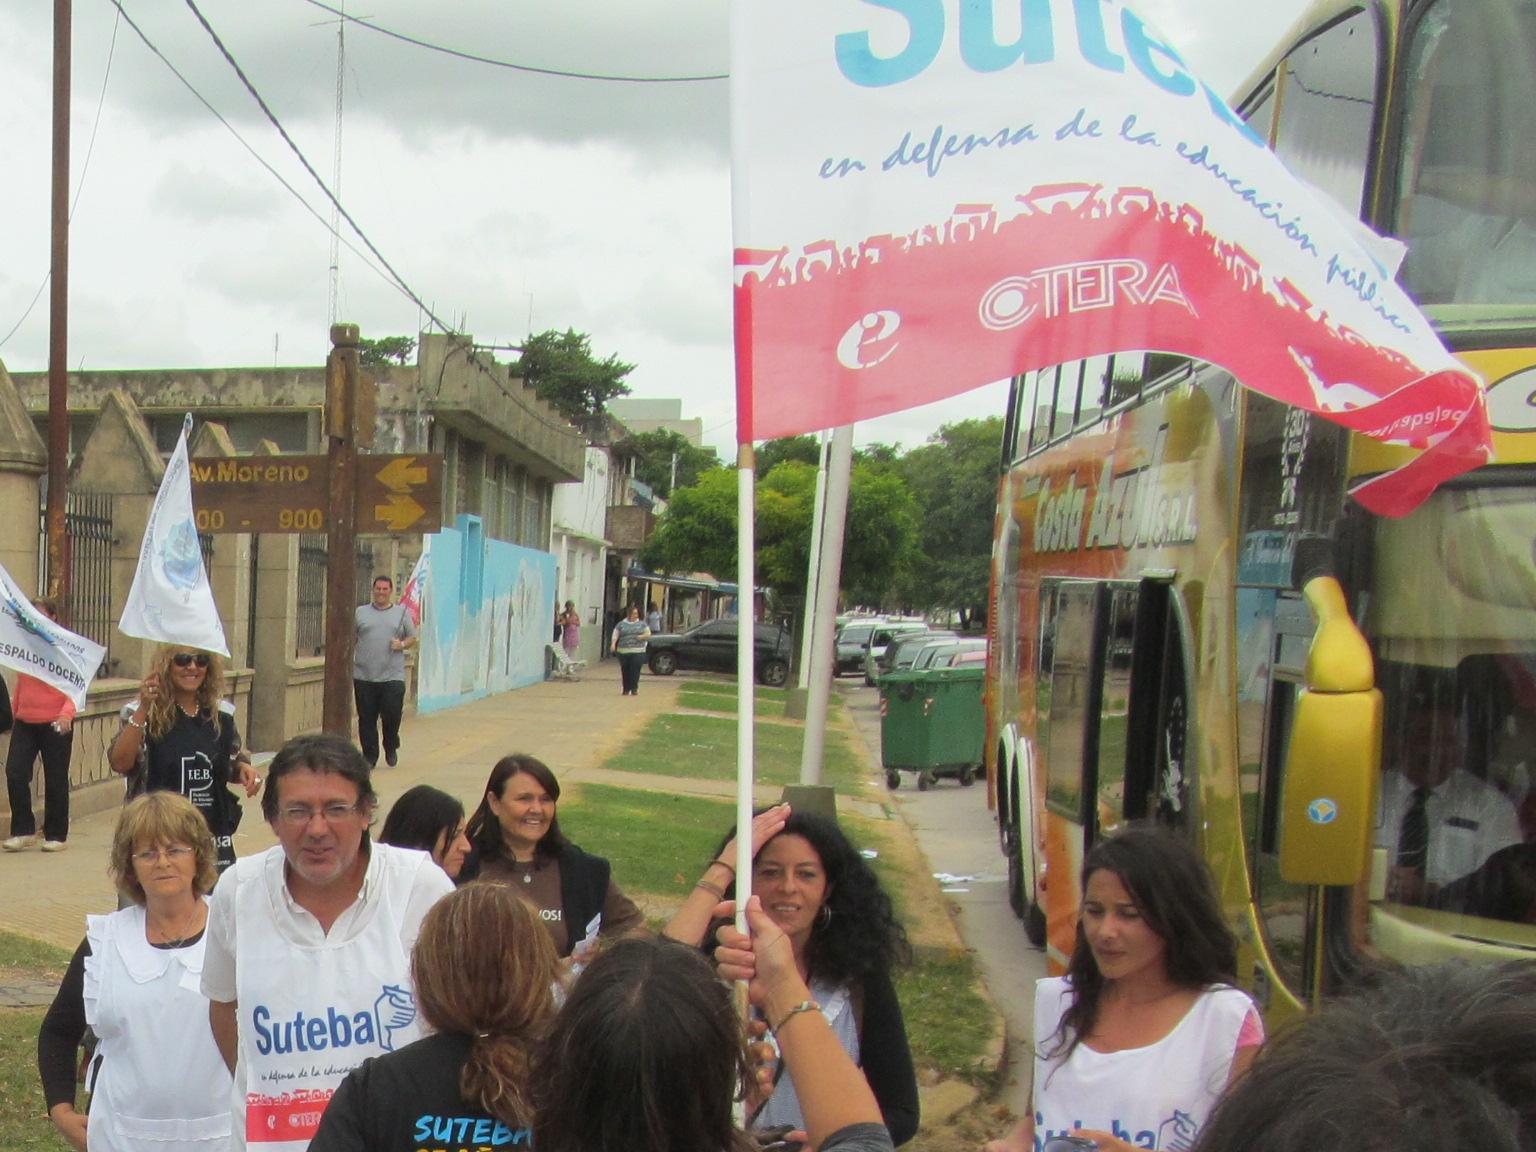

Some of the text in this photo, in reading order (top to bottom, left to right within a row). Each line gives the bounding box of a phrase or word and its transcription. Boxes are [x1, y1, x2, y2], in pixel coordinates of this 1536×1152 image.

[835, 0, 1209, 110] Sute
[818, 157, 866, 179] en
[881, 124, 1040, 178] defensa
[1055, 107, 1104, 141] de
[1118, 114, 1162, 148] la
[1175, 141, 1318, 257] educación
[978, 258, 1200, 332] CTERA
[195, 509, 225, 530] 00
[278, 508, 323, 530] 900
[538, 909, 562, 922] OS!
[253, 1005, 375, 1056] Suteba
[288, 1111, 322, 1128] CTER
[413, 1114, 533, 1149] SUTEBA
